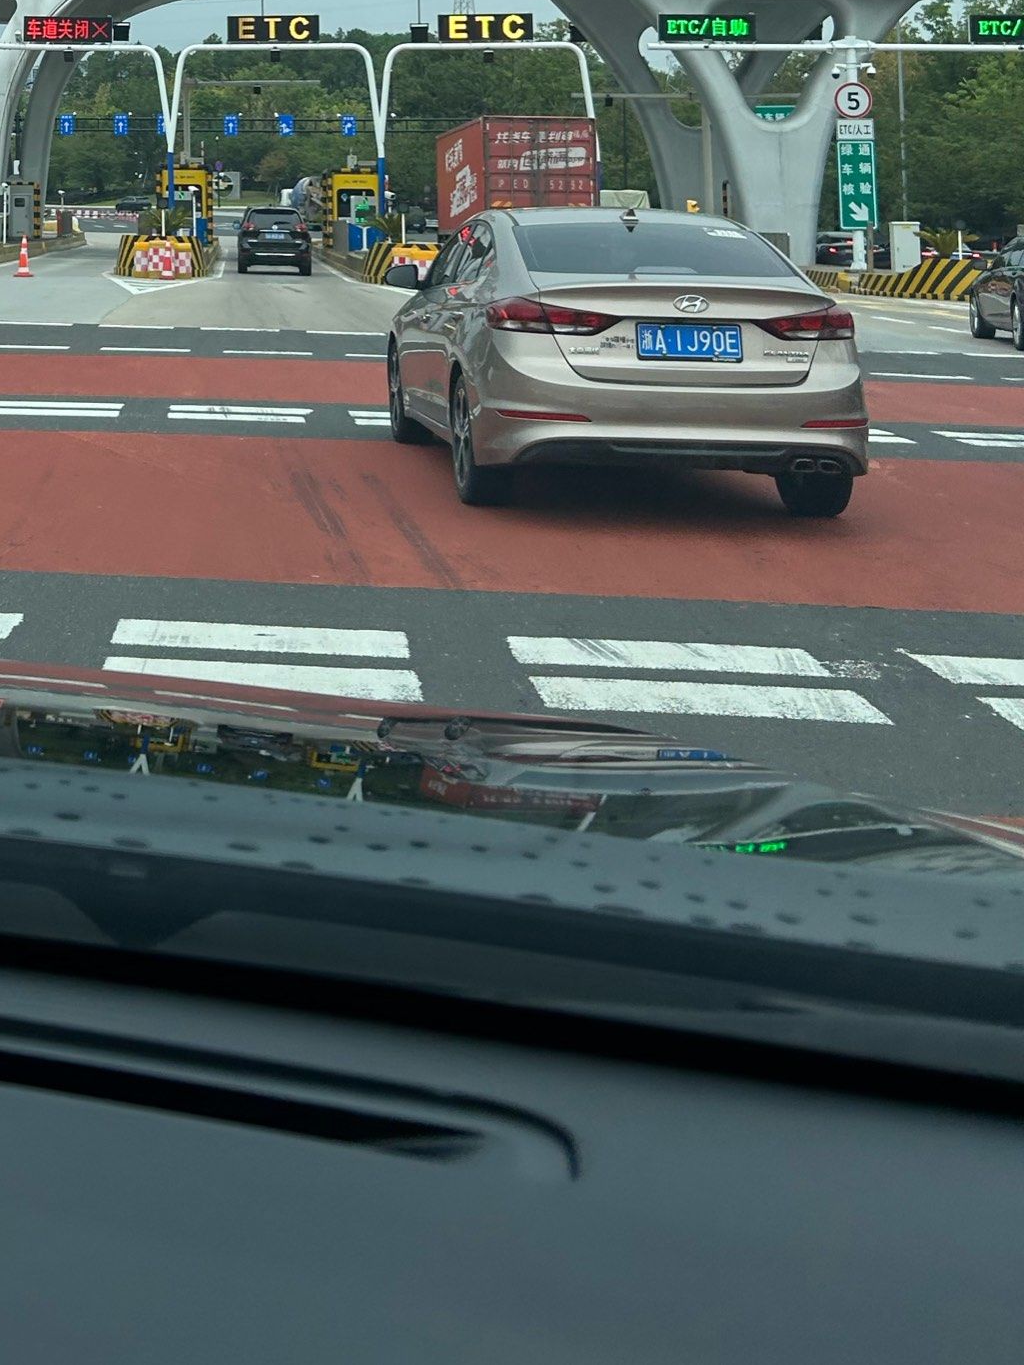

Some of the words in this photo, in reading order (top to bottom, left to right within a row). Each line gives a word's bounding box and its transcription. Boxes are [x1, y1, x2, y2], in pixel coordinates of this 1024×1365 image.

[26, 19, 89, 39] 车道关闭
[238, 17, 310, 40] ETC
[447, 14, 525, 39] ETC
[667, 17, 749, 36] ETC/自助
[847, 92, 860, 110] 5
[839, 124, 872, 135] ETC/人工
[840, 144, 871, 155] 绿通
[841, 162, 872, 176] 车辆
[842, 181, 872, 195] 核验
